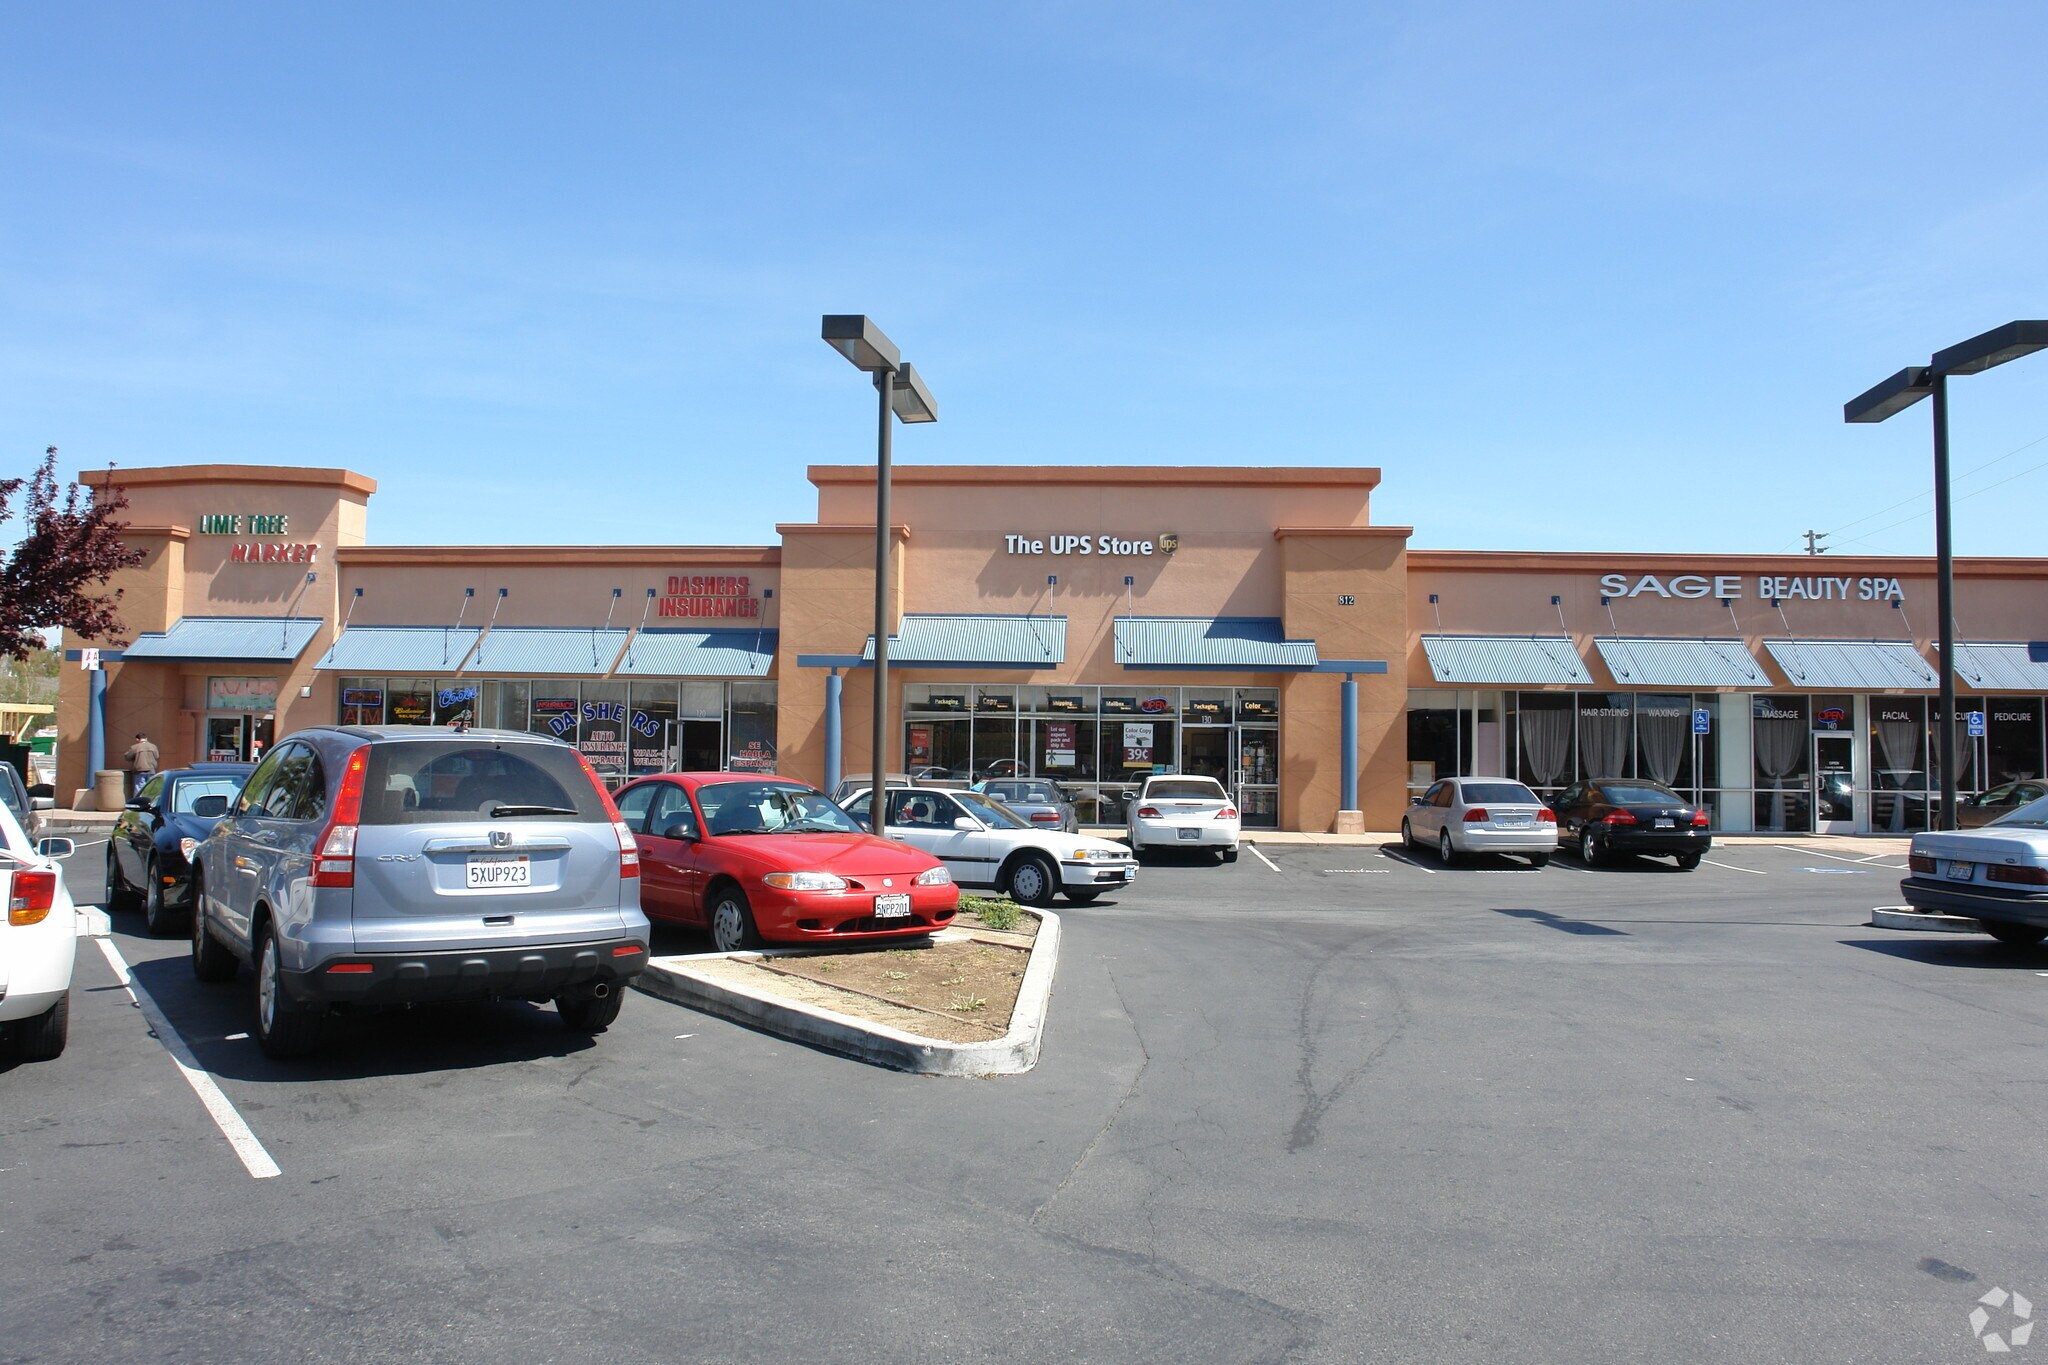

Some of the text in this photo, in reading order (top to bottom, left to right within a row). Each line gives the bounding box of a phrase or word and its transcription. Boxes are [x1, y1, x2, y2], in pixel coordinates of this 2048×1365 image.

[199, 514, 288, 535] LIME TREE
[1005, 534, 1152, 555] The UPS Store
[1160, 539, 1177, 554] ups
[230, 543, 321, 563] MARKET
[667, 576, 749, 596] DASHERS
[1600, 573, 1905, 600] SAGE BEAUTY SPA
[1339, 595, 1354, 605] 812
[658, 598, 758, 617] INSURANCE
[437, 686, 478, 708] Coors
[934, 698, 959, 706] Packaging
[983, 697, 998, 706] Copy
[1142, 700, 1168, 711] OPEN
[1193, 703, 1218, 711] Packaging
[344, 708, 379, 724] ATM
[1581, 708, 1629, 717] HAIR STYLING
[1648, 709, 1680, 718] WAXING
[1762, 710, 1799, 719] MASSAGE
[1817, 710, 1844, 720] OPEN
[1882, 711, 1909, 720] FACIAL
[1994, 712, 2032, 721] PEDICURE
[1201, 715, 1212, 723] 130
[1139, 727, 1152, 735] Copy
[1827, 722, 1837, 730] 140
[590, 730, 616, 741] AUTO
[580, 741, 627, 752] INSURANCE
[749, 741, 761, 749] SE
[740, 750, 771, 758] HABLA
[1127, 748, 1149, 760] 39¢
[587, 755, 625, 765] OW-RATES
[471, 866, 526, 883] 5XUP923
